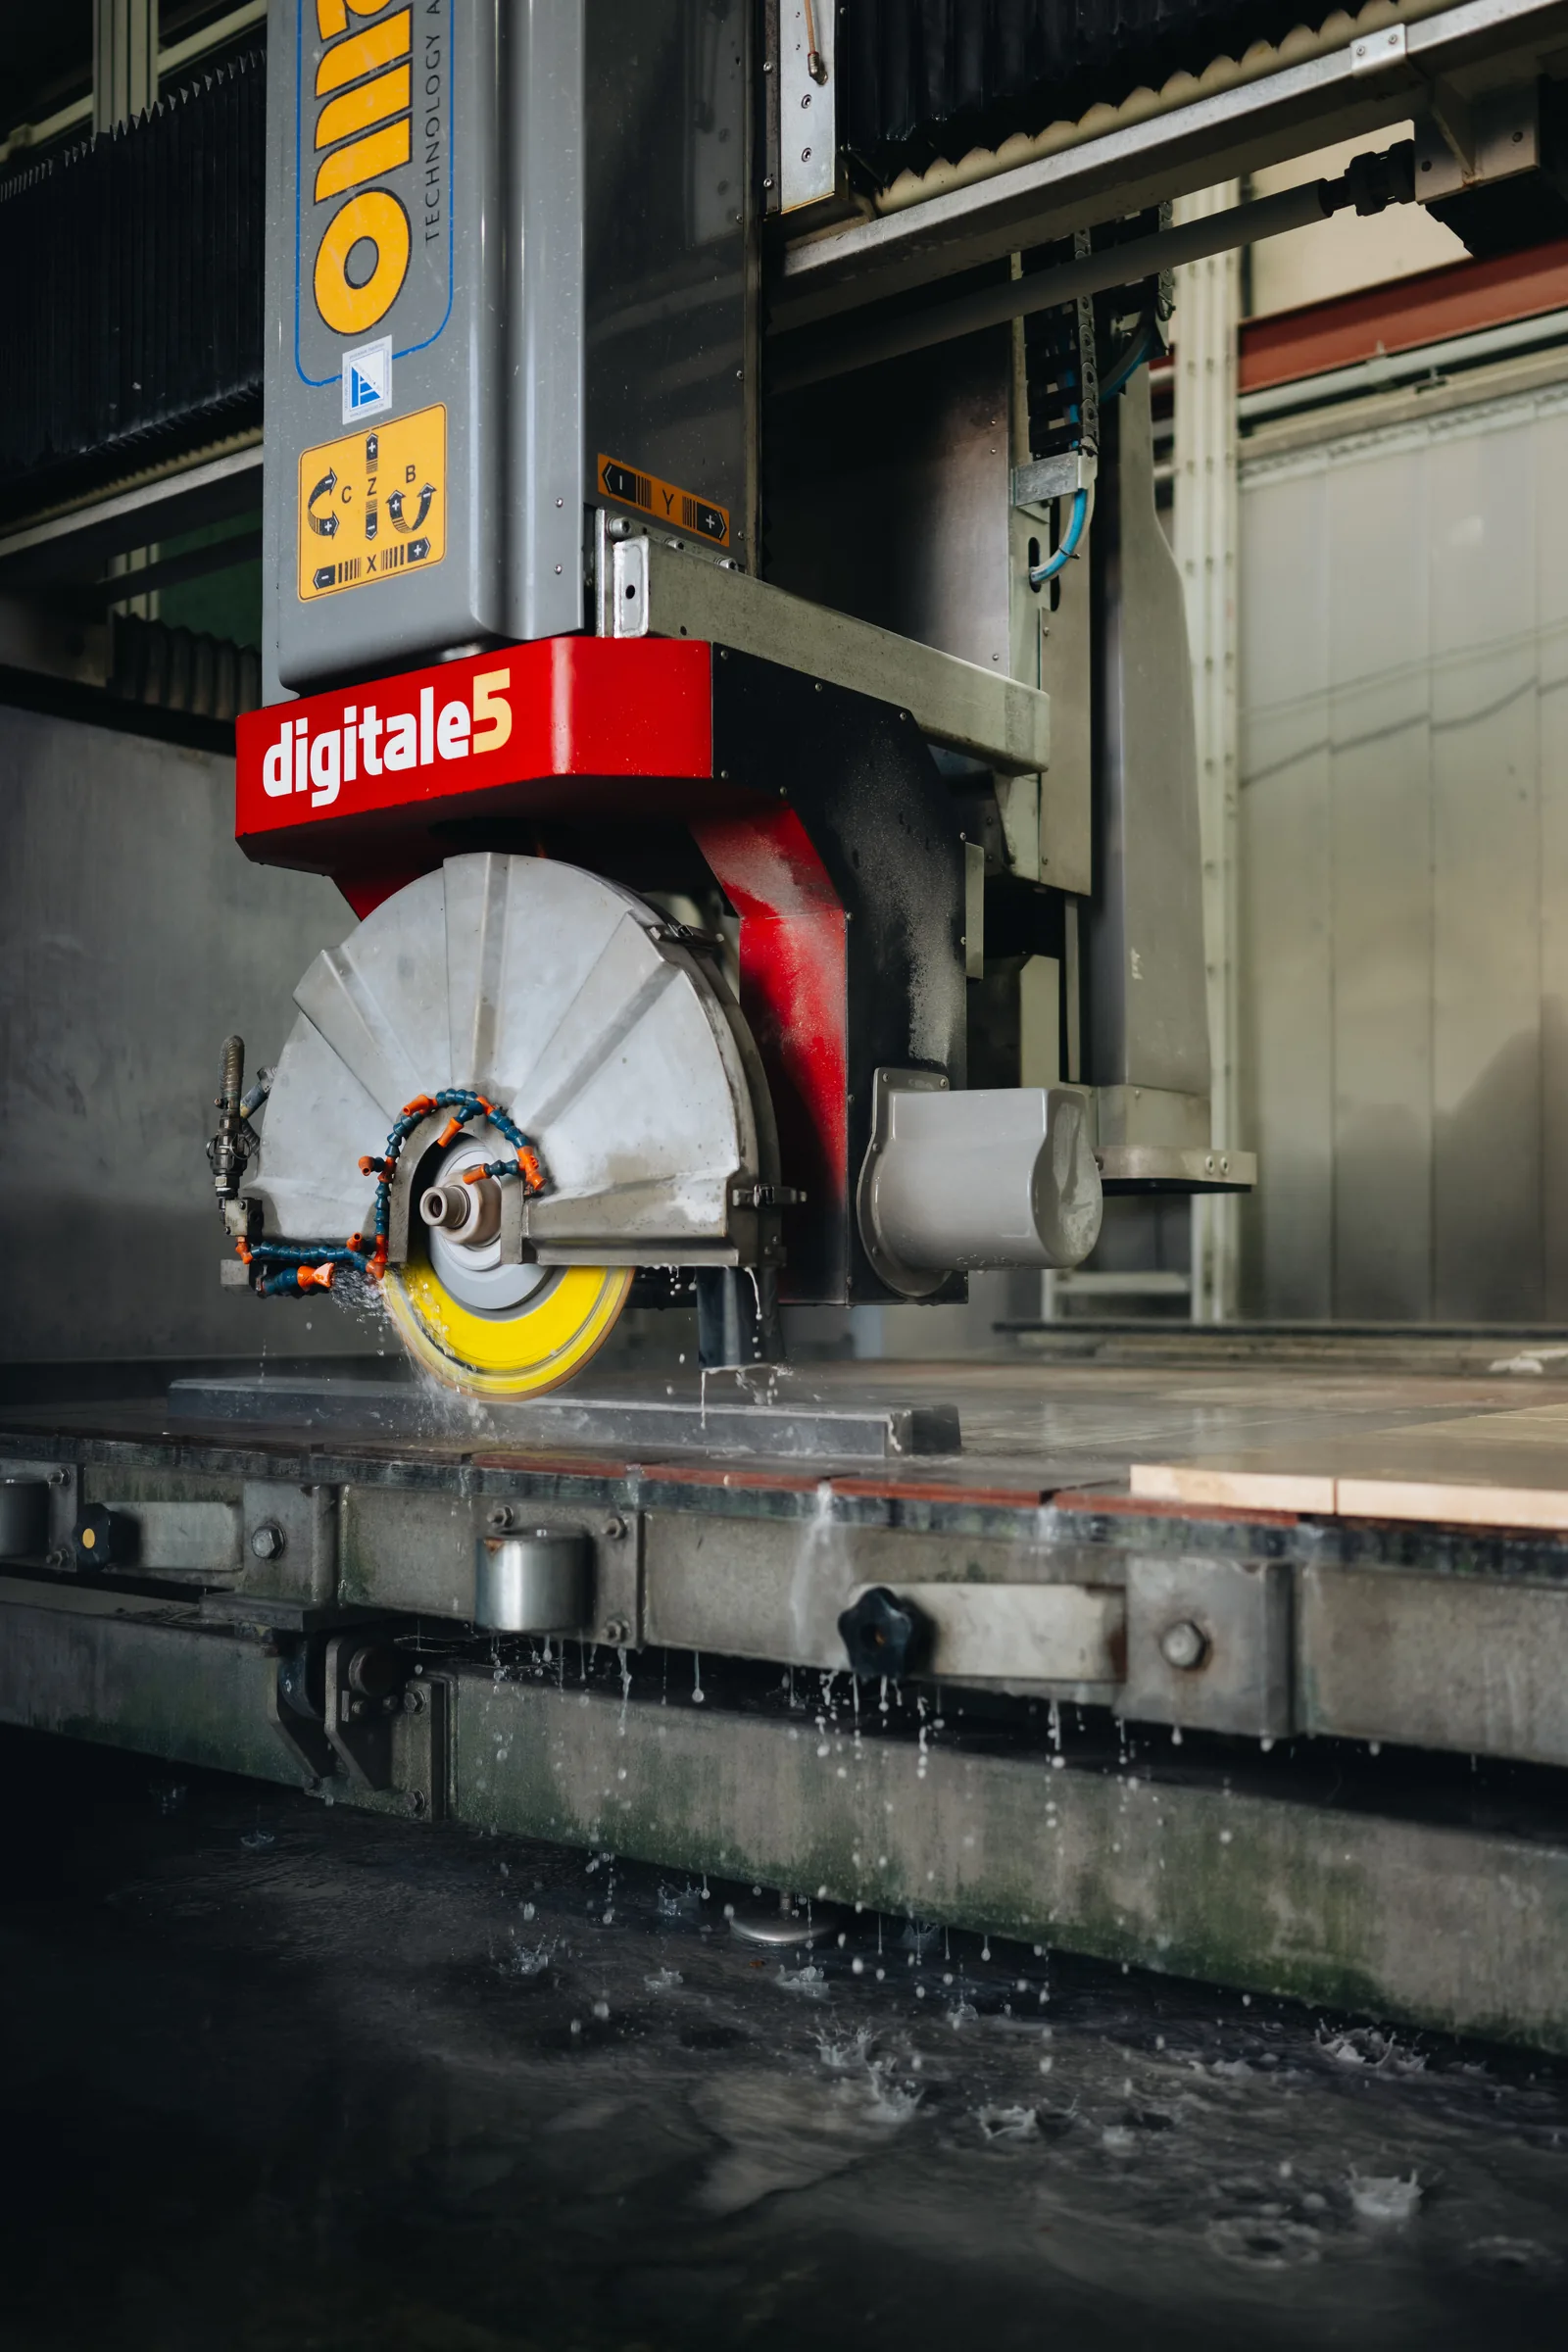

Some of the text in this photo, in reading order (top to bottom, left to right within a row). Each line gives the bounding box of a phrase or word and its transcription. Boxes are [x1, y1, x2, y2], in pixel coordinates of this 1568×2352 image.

[424, 33, 441, 247] TECHNOLOGY
[405, 464, 416, 484] B
[341, 485, 352, 504] C
[367, 476, 377, 497] Z
[662, 488, 674, 515] Y
[366, 554, 377, 573] X
[263, 667, 513, 808] digitale5
